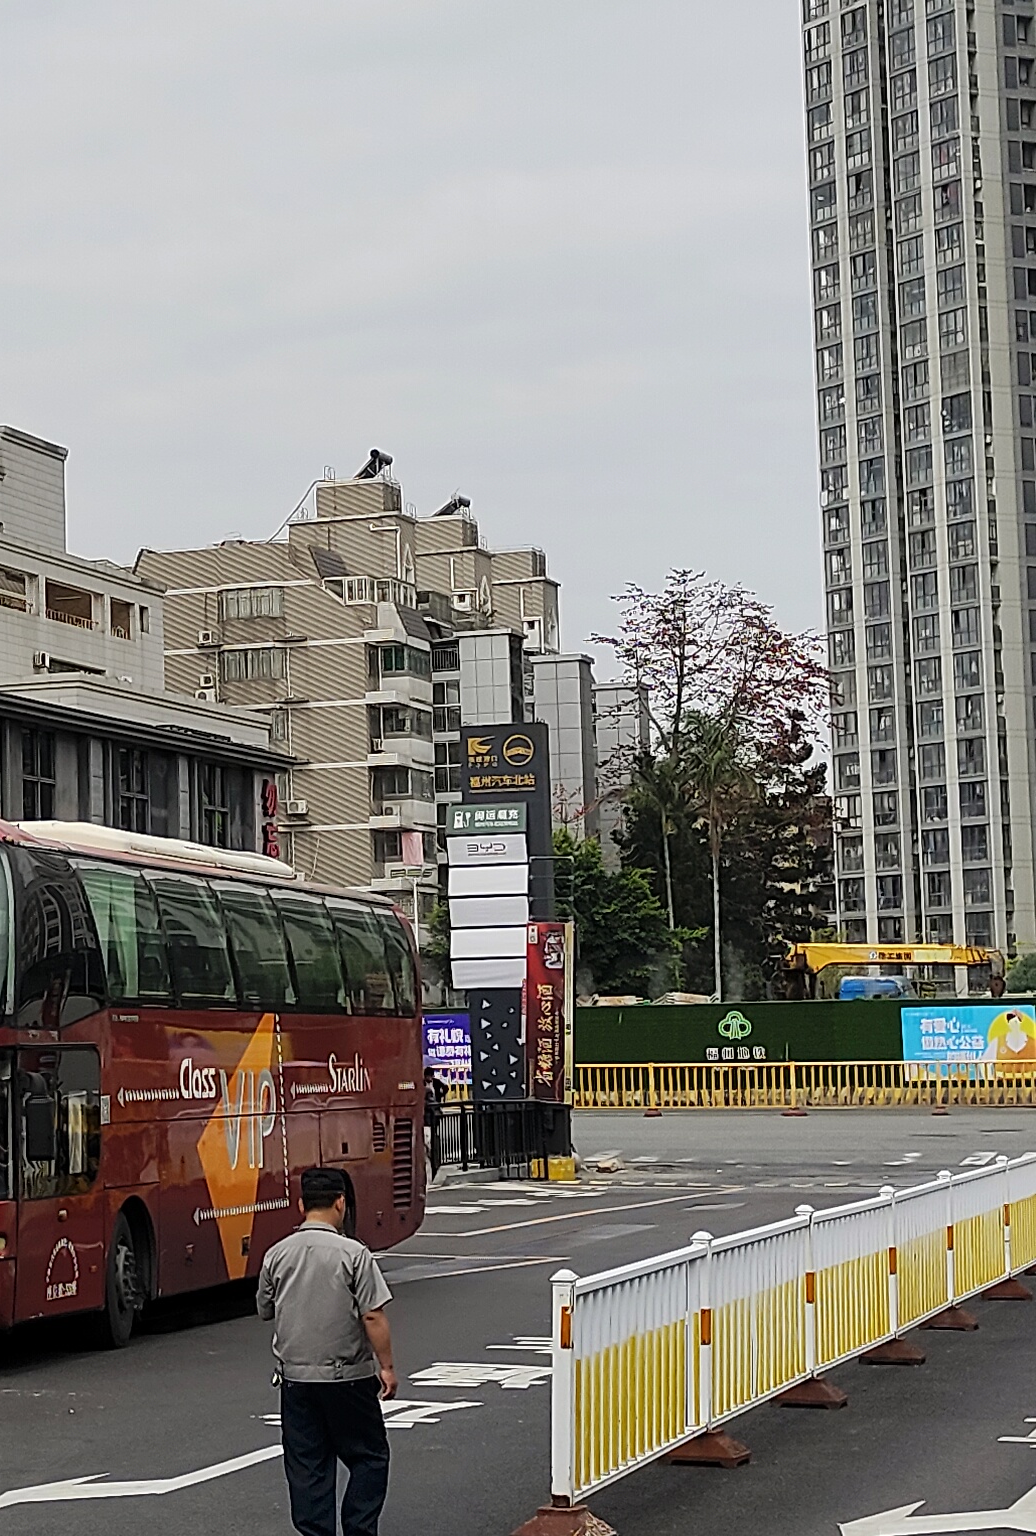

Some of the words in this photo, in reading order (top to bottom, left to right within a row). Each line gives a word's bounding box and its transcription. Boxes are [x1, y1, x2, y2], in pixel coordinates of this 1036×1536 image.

[466, 843, 506, 853] BYD
[180, 1058, 216, 1099] Class
[219, 1068, 276, 1170] VIP
